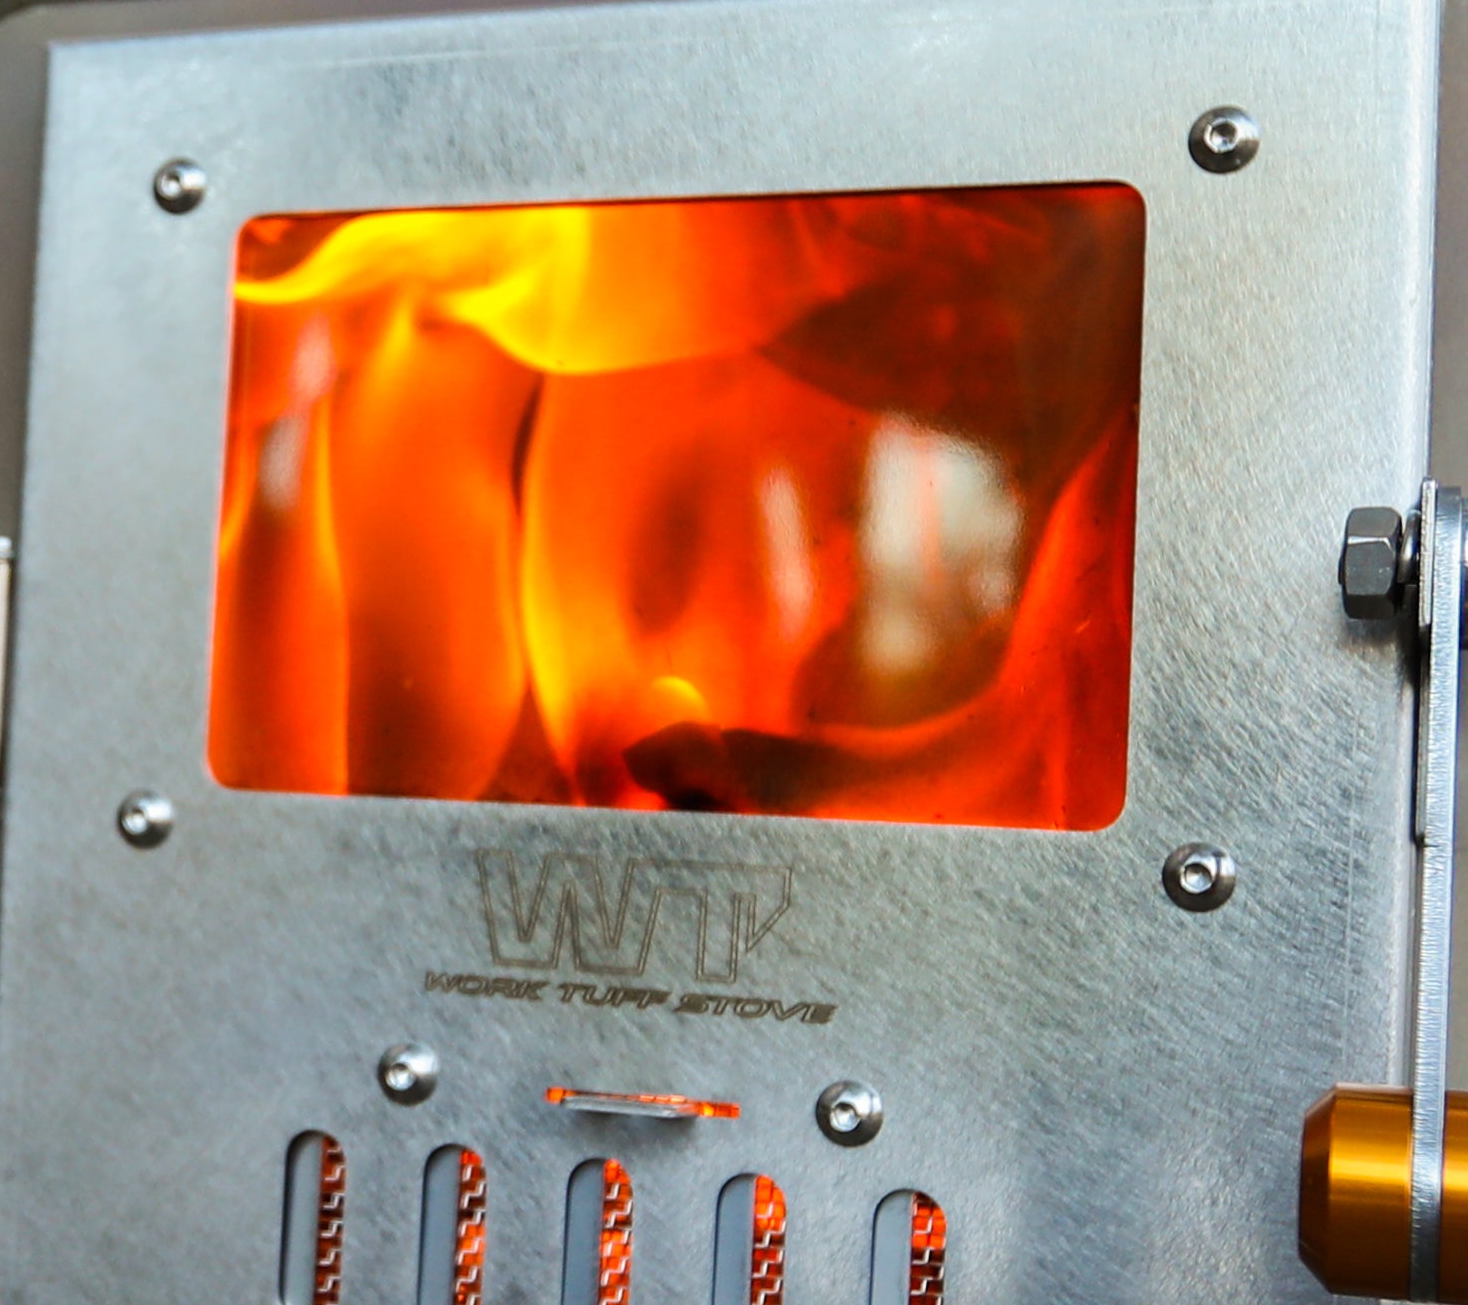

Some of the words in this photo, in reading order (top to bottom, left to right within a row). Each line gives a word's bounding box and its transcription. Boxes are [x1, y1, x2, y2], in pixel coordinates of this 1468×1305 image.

[423, 970, 550, 1002] WORK
[558, 982, 673, 1011] TUFF
[673, 993, 839, 1025] STOVE
